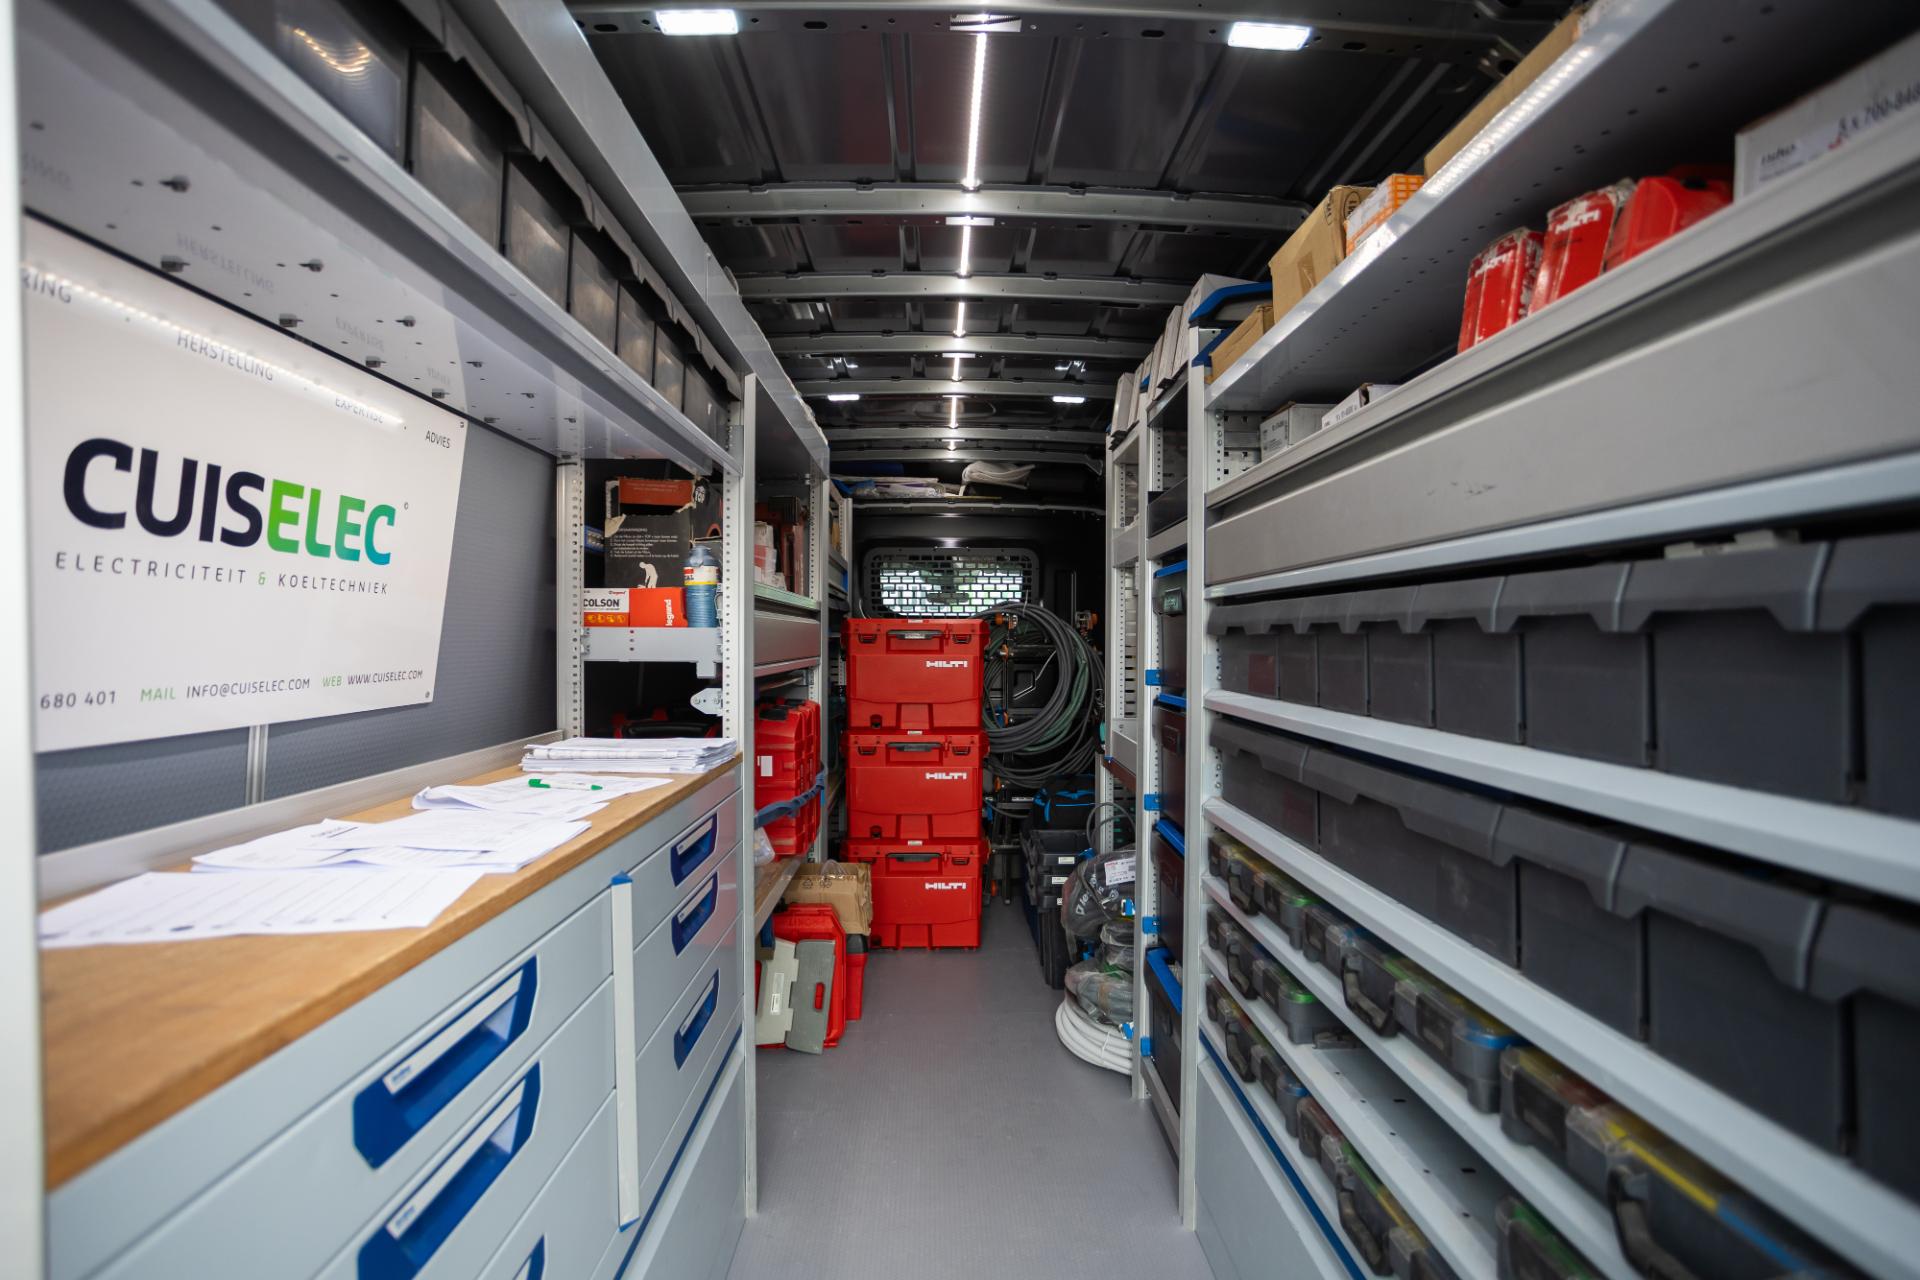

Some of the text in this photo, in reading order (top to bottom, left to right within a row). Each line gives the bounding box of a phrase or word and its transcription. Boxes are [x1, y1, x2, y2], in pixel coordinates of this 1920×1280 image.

[176, 330, 274, 382] HERSTELLING
[425, 430, 451, 449] ADVIES
[63, 437, 397, 566] CUISELEC
[55, 551, 389, 596] ELECTRICITEIT & KOELTECHNIEK
[583, 598, 620, 608] COLSON
[663, 599, 675, 626] legrand
[925, 660, 968, 668] HILTI
[40, 670, 424, 710] 680 401 MAIL INFO@CUISELEC.COM WEB WWW.CUISELEC.COM
[925, 772, 967, 780] HILTI
[925, 882, 967, 890] HILTI
